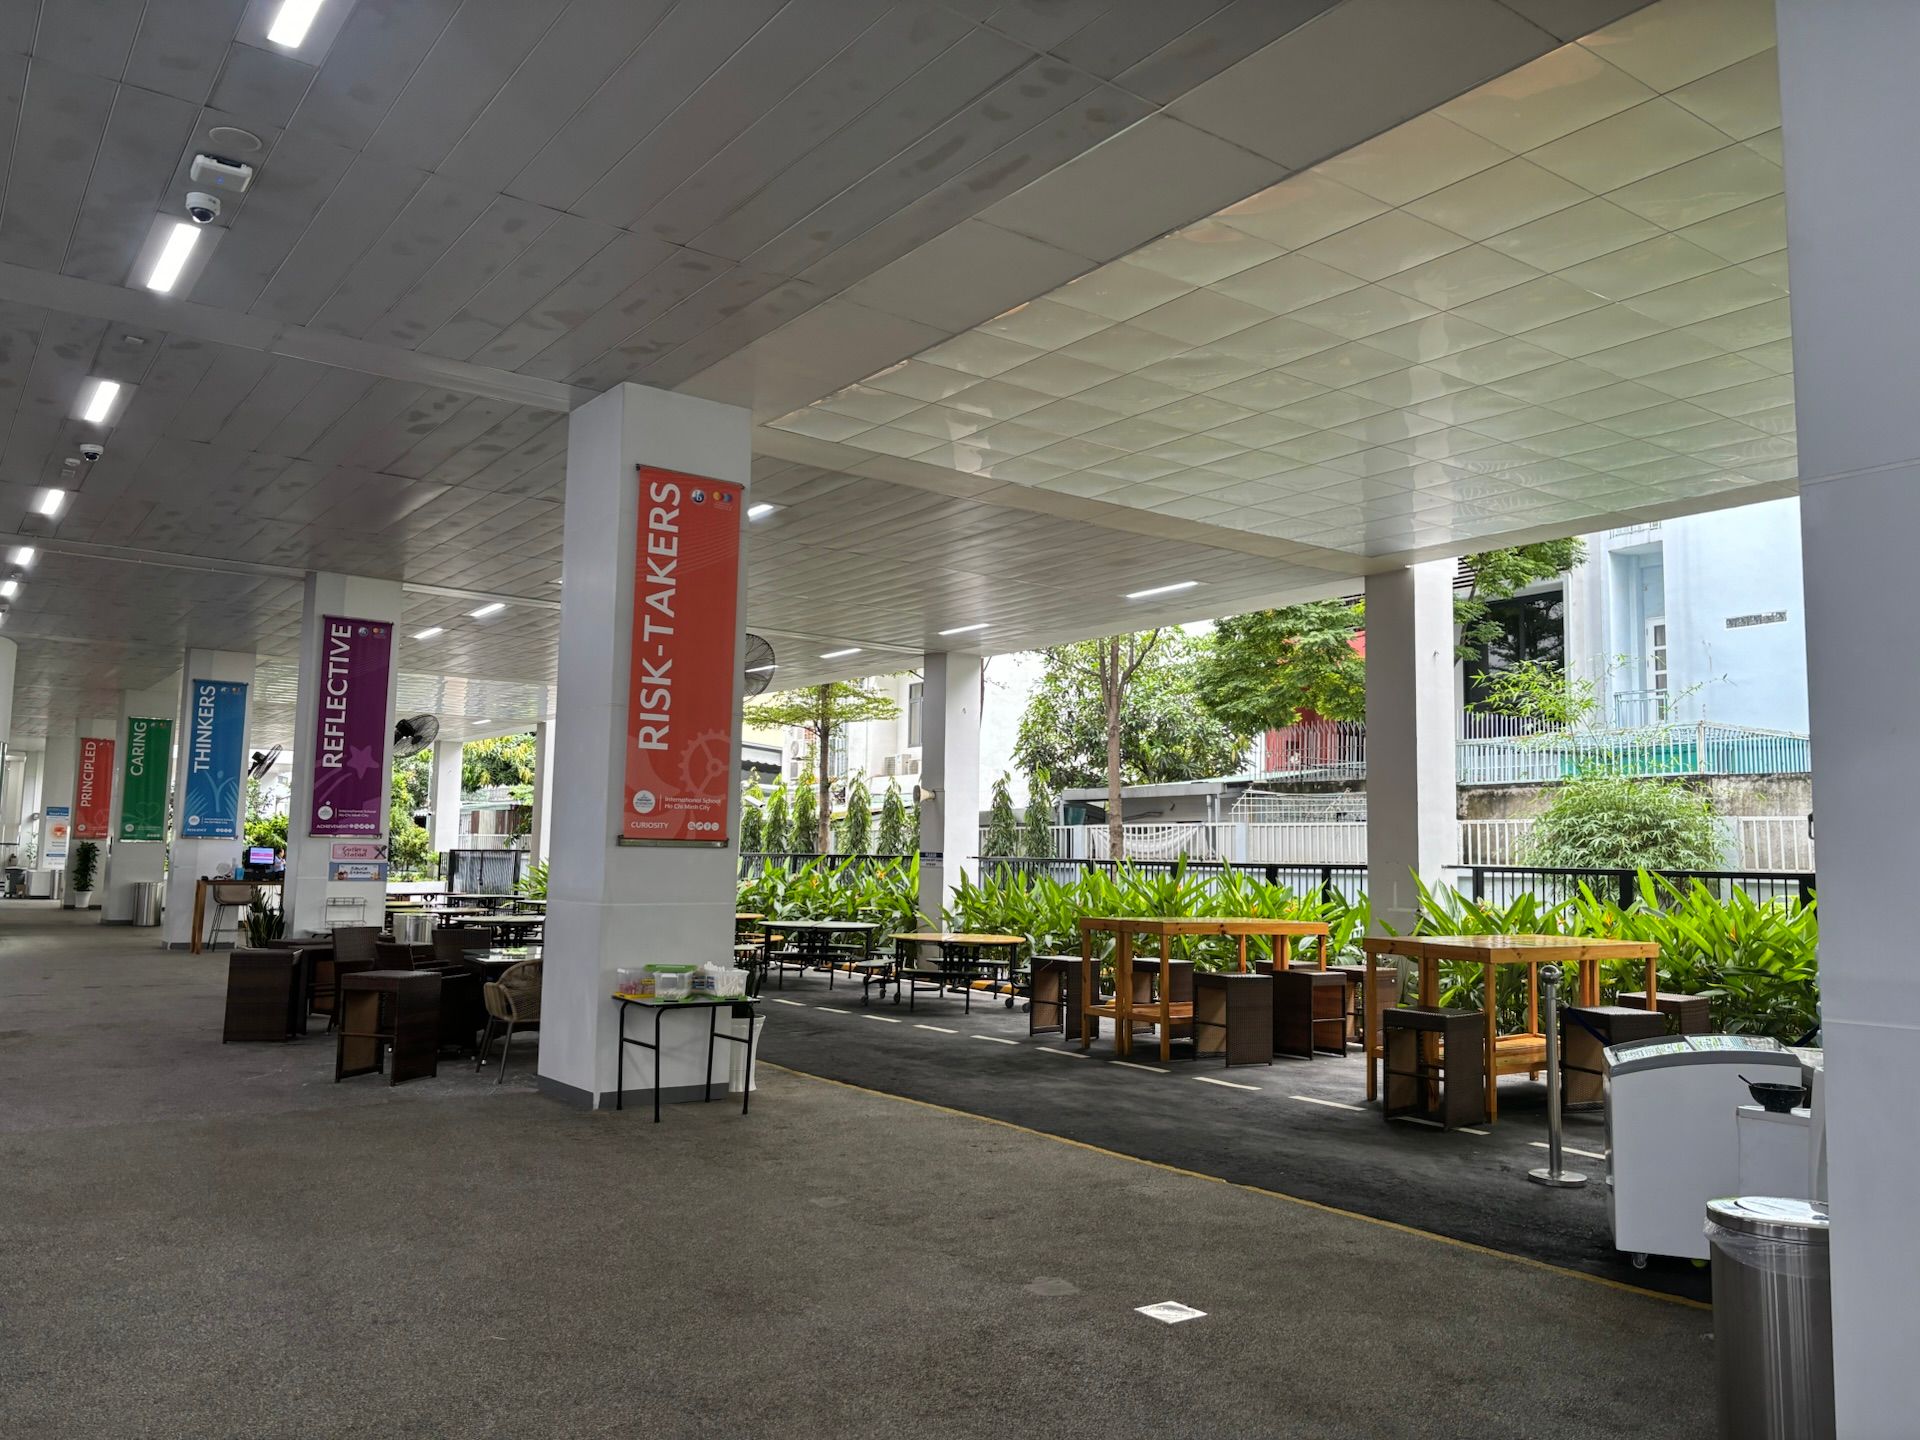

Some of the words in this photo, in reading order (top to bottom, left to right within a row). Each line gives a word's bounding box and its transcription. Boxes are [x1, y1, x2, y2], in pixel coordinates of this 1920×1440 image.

[638, 481, 681, 751] RISK-TAKERS
[194, 685, 216, 774] THINKERS
[322, 623, 352, 768] REFLECTIVE
[80, 741, 97, 807] PRINCIPLED
[130, 721, 148, 777] CARING
[631, 821, 669, 829] CURIOSITY
